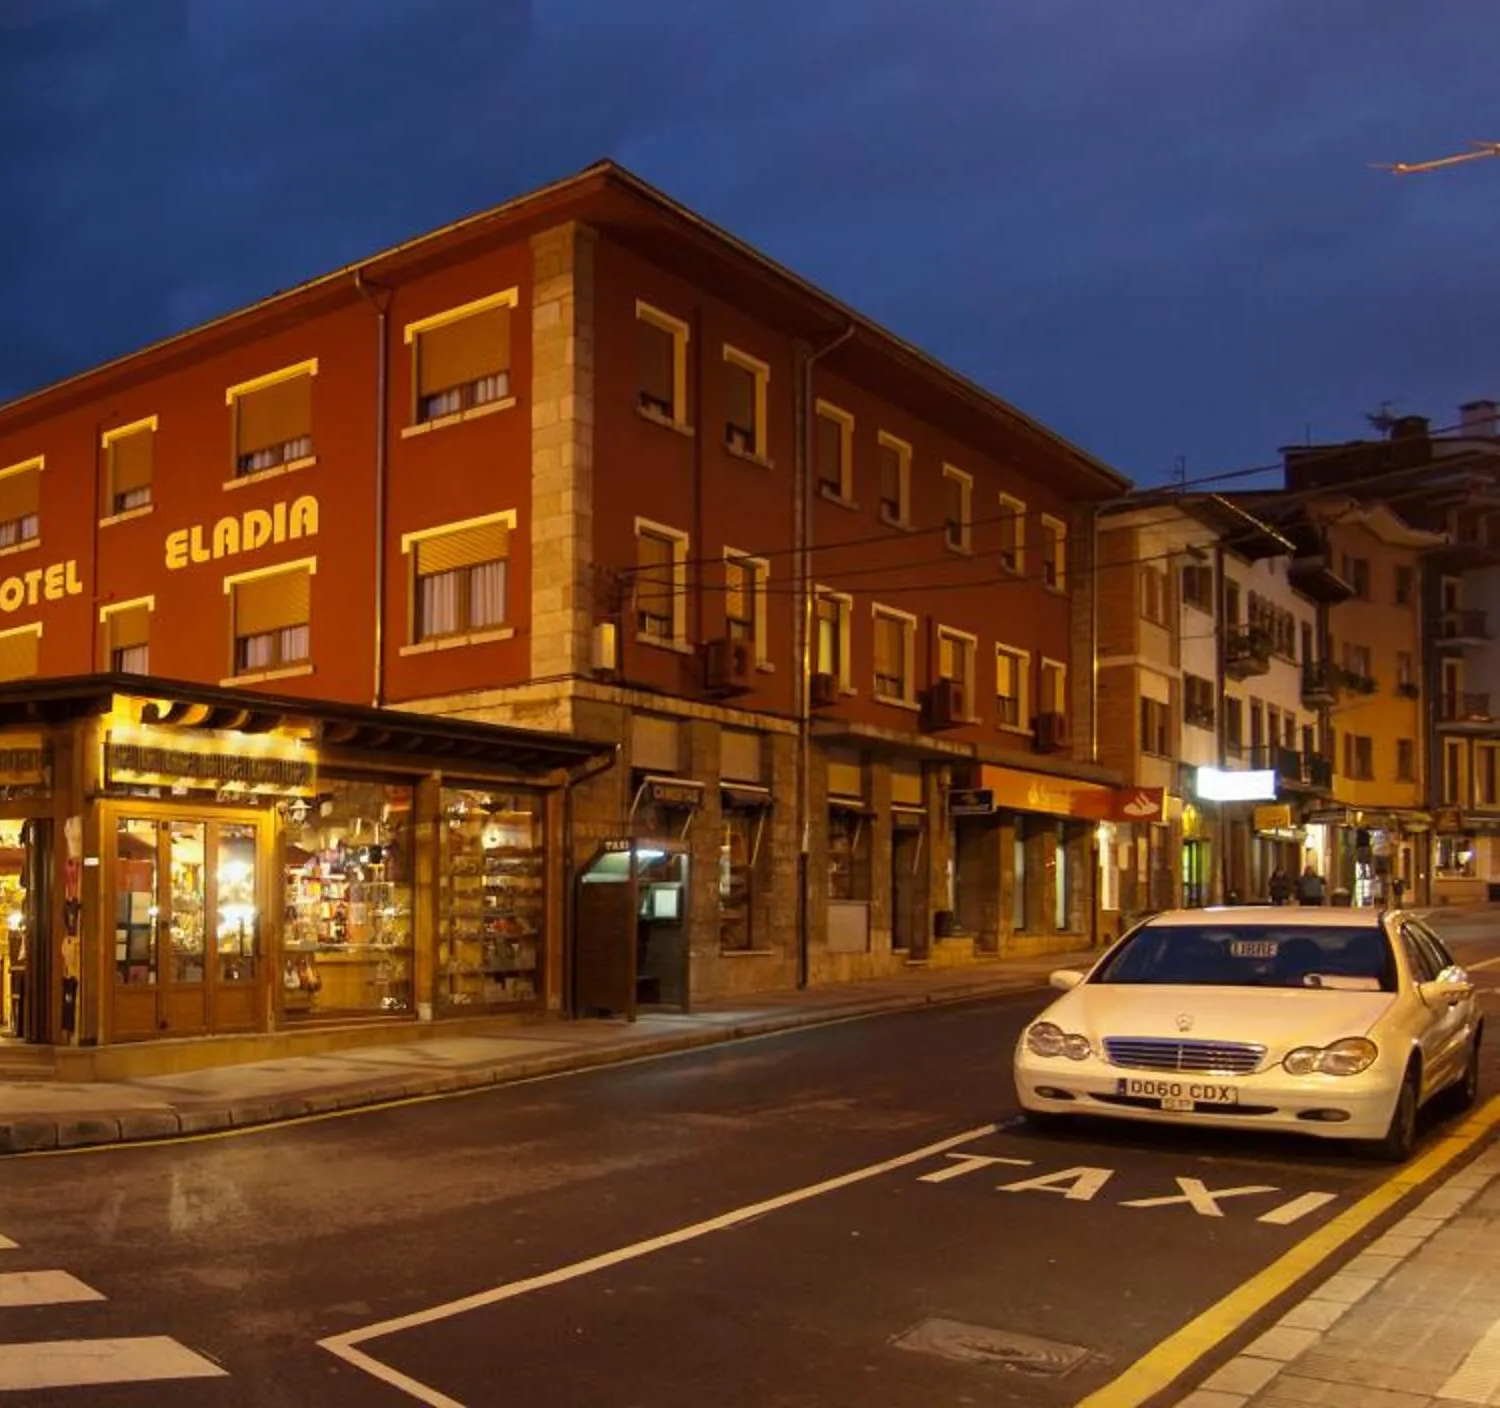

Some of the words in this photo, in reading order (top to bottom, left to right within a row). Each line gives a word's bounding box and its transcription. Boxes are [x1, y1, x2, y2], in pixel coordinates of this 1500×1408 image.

[164, 495, 319, 570] ELADIA
[604, 841, 630, 851] TAXI
[1130, 1080, 1182, 1098] 0060
[1189, 1083, 1230, 1102] CDX
[916, 1152, 1338, 1225] TAXI
